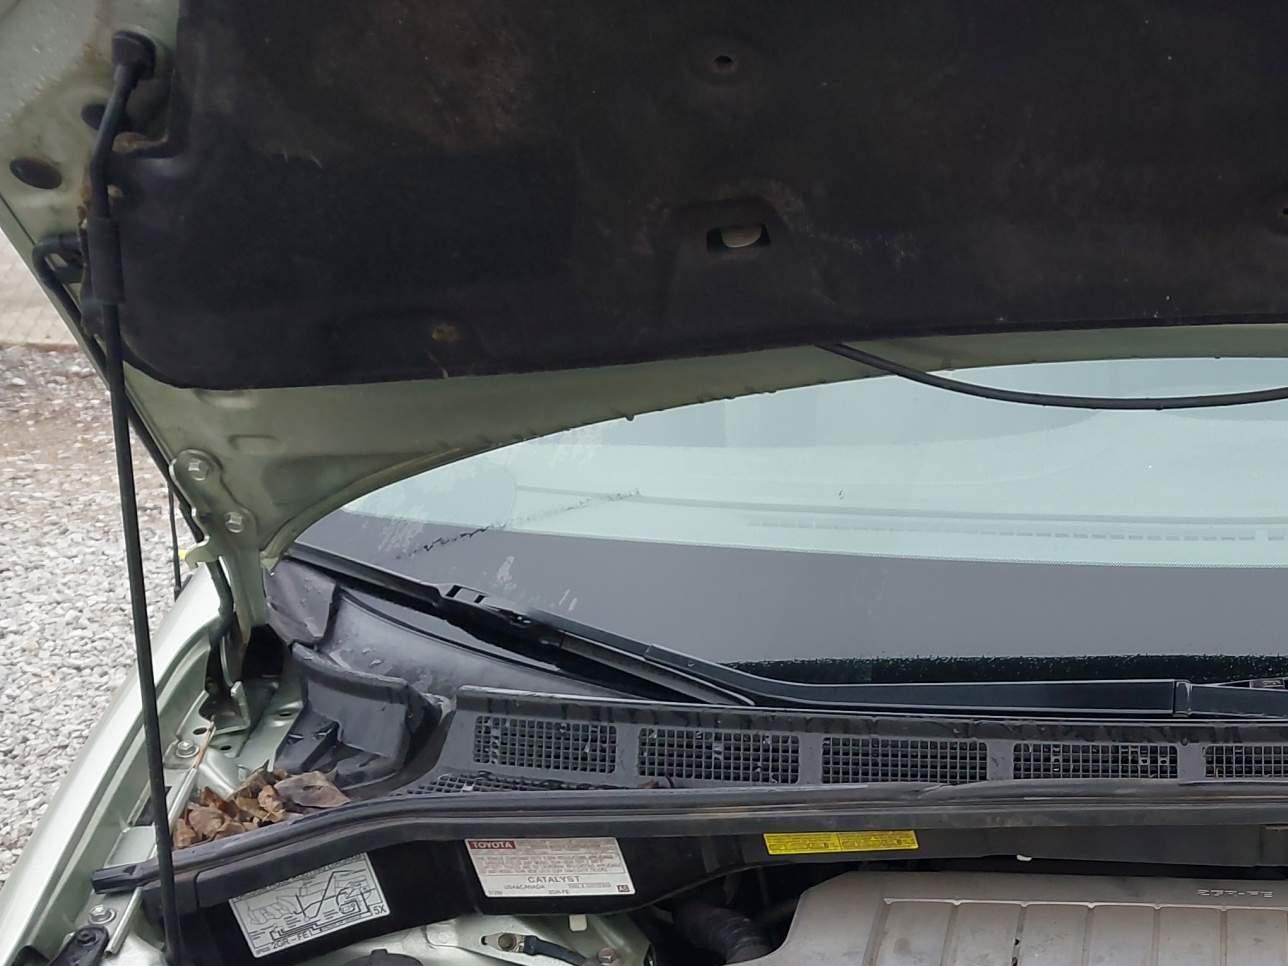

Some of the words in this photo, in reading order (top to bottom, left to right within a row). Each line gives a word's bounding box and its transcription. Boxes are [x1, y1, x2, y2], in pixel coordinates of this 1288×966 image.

[472, 841, 514, 849] TOYOTA
[527, 875, 580, 883] CATALYST
[372, 904, 386, 916] 5X
